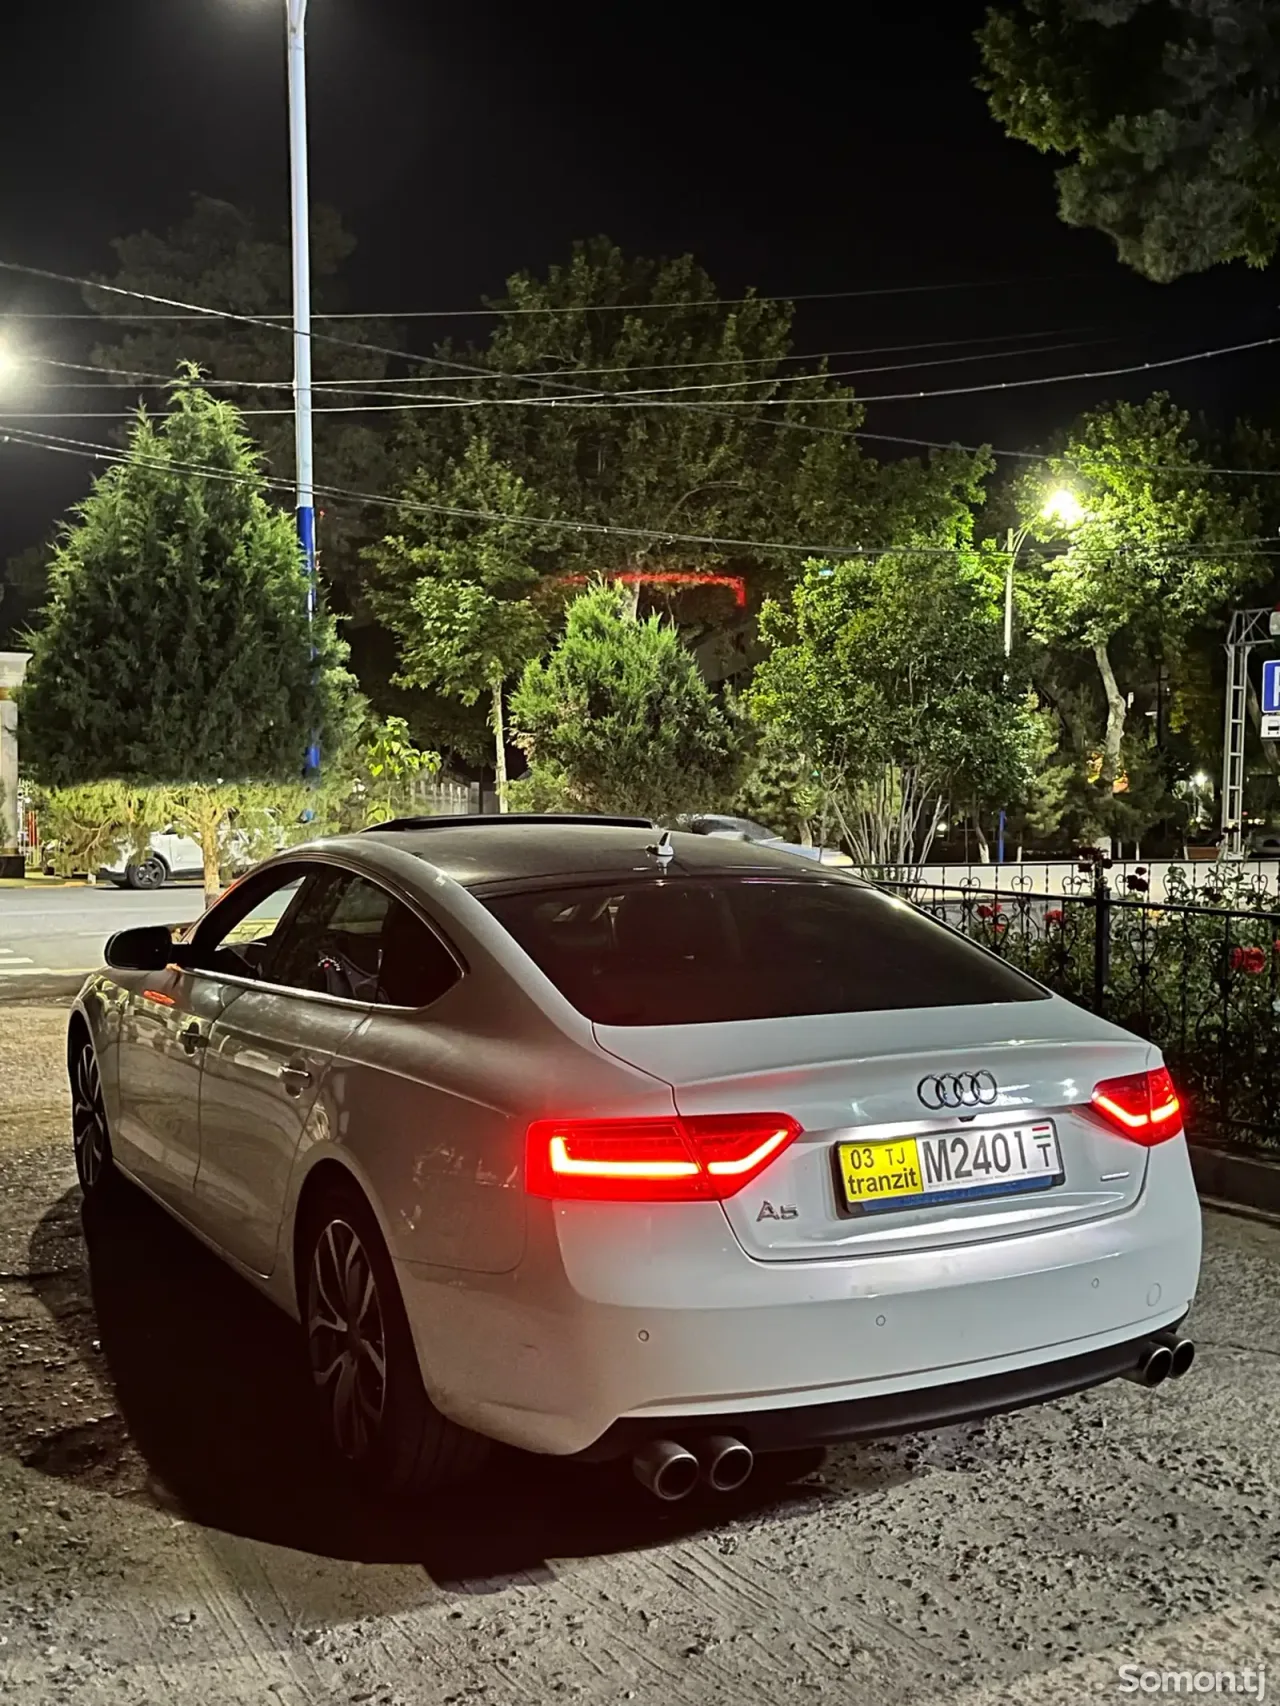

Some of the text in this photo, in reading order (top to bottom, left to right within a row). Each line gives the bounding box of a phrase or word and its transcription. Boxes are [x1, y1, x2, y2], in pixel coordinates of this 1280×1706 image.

[851, 1147, 874, 1170] 03
[922, 1130, 1028, 1184] M2401
[1037, 1143, 1051, 1168] T
[848, 1167, 918, 1195] tranzit
[756, 1200, 799, 1222] A5
